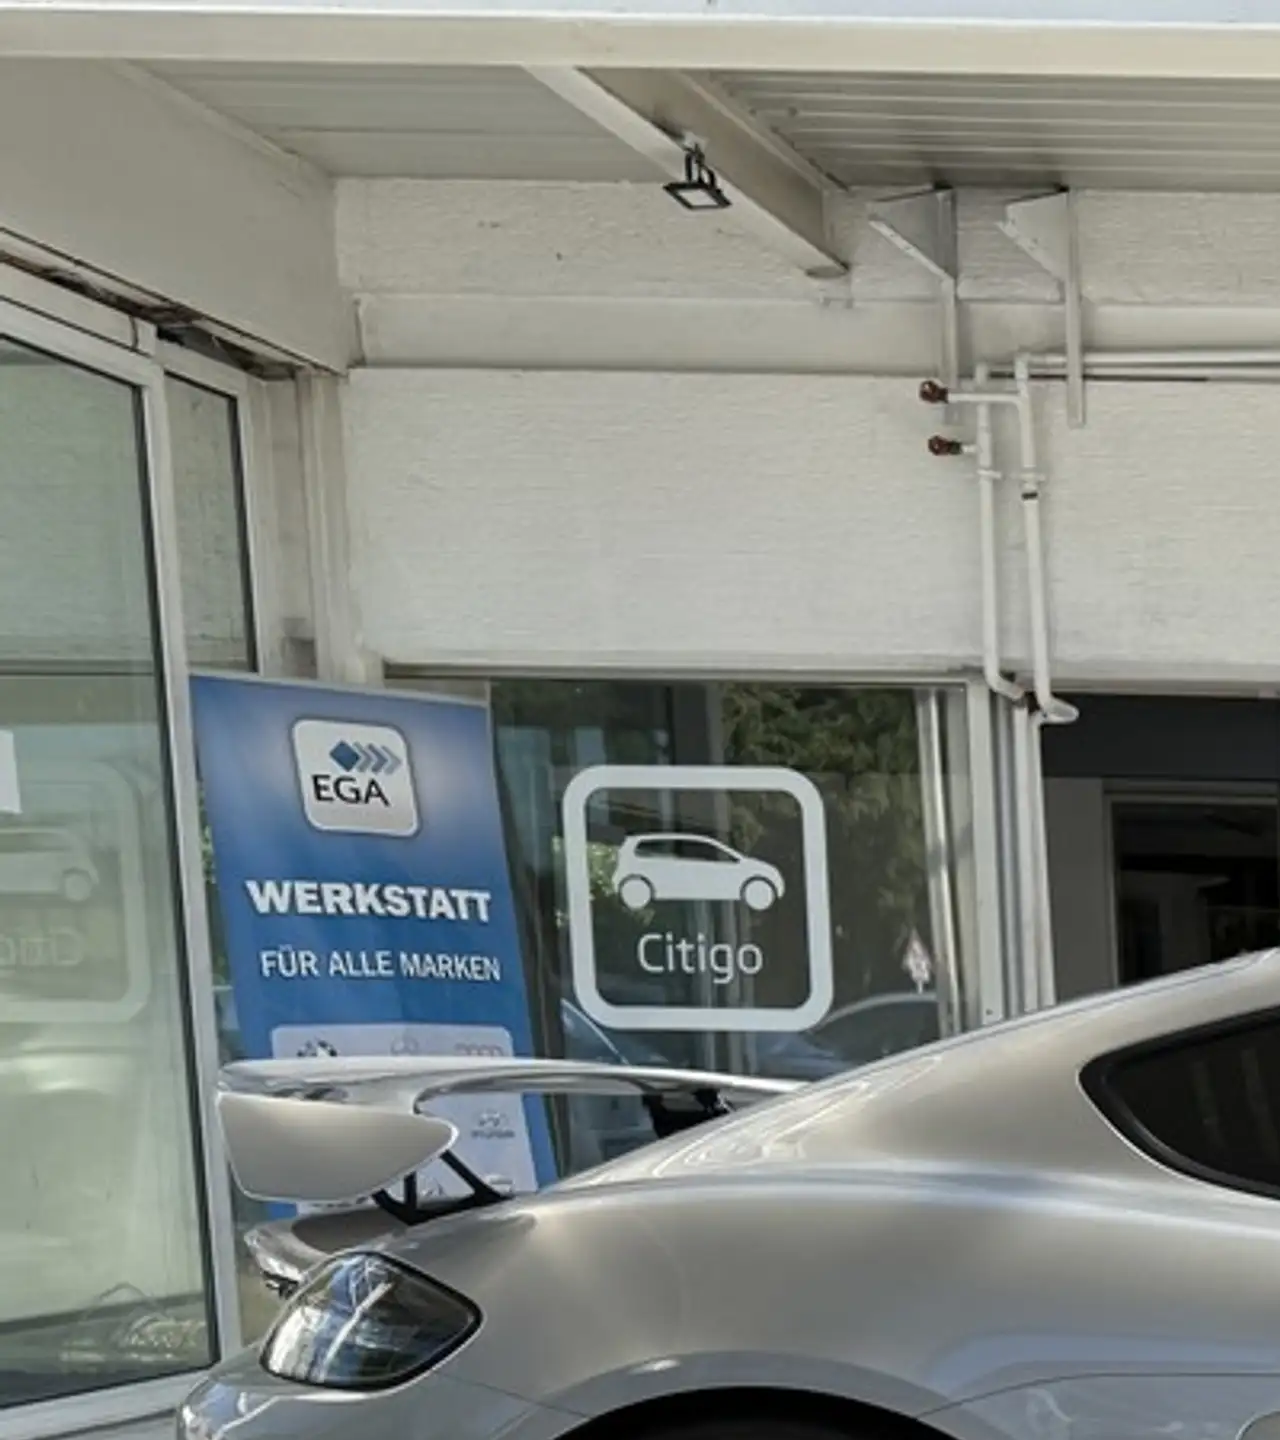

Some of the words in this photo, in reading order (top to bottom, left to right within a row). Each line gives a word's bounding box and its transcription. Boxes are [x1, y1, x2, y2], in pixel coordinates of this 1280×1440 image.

[311, 773, 390, 807] EGA
[245, 879, 491, 921] WERKSTATT
[260, 945, 319, 978] FÜR
[328, 950, 394, 977] ALLE
[400, 953, 500, 981] MARKEN
[637, 932, 763, 983] Citigo
